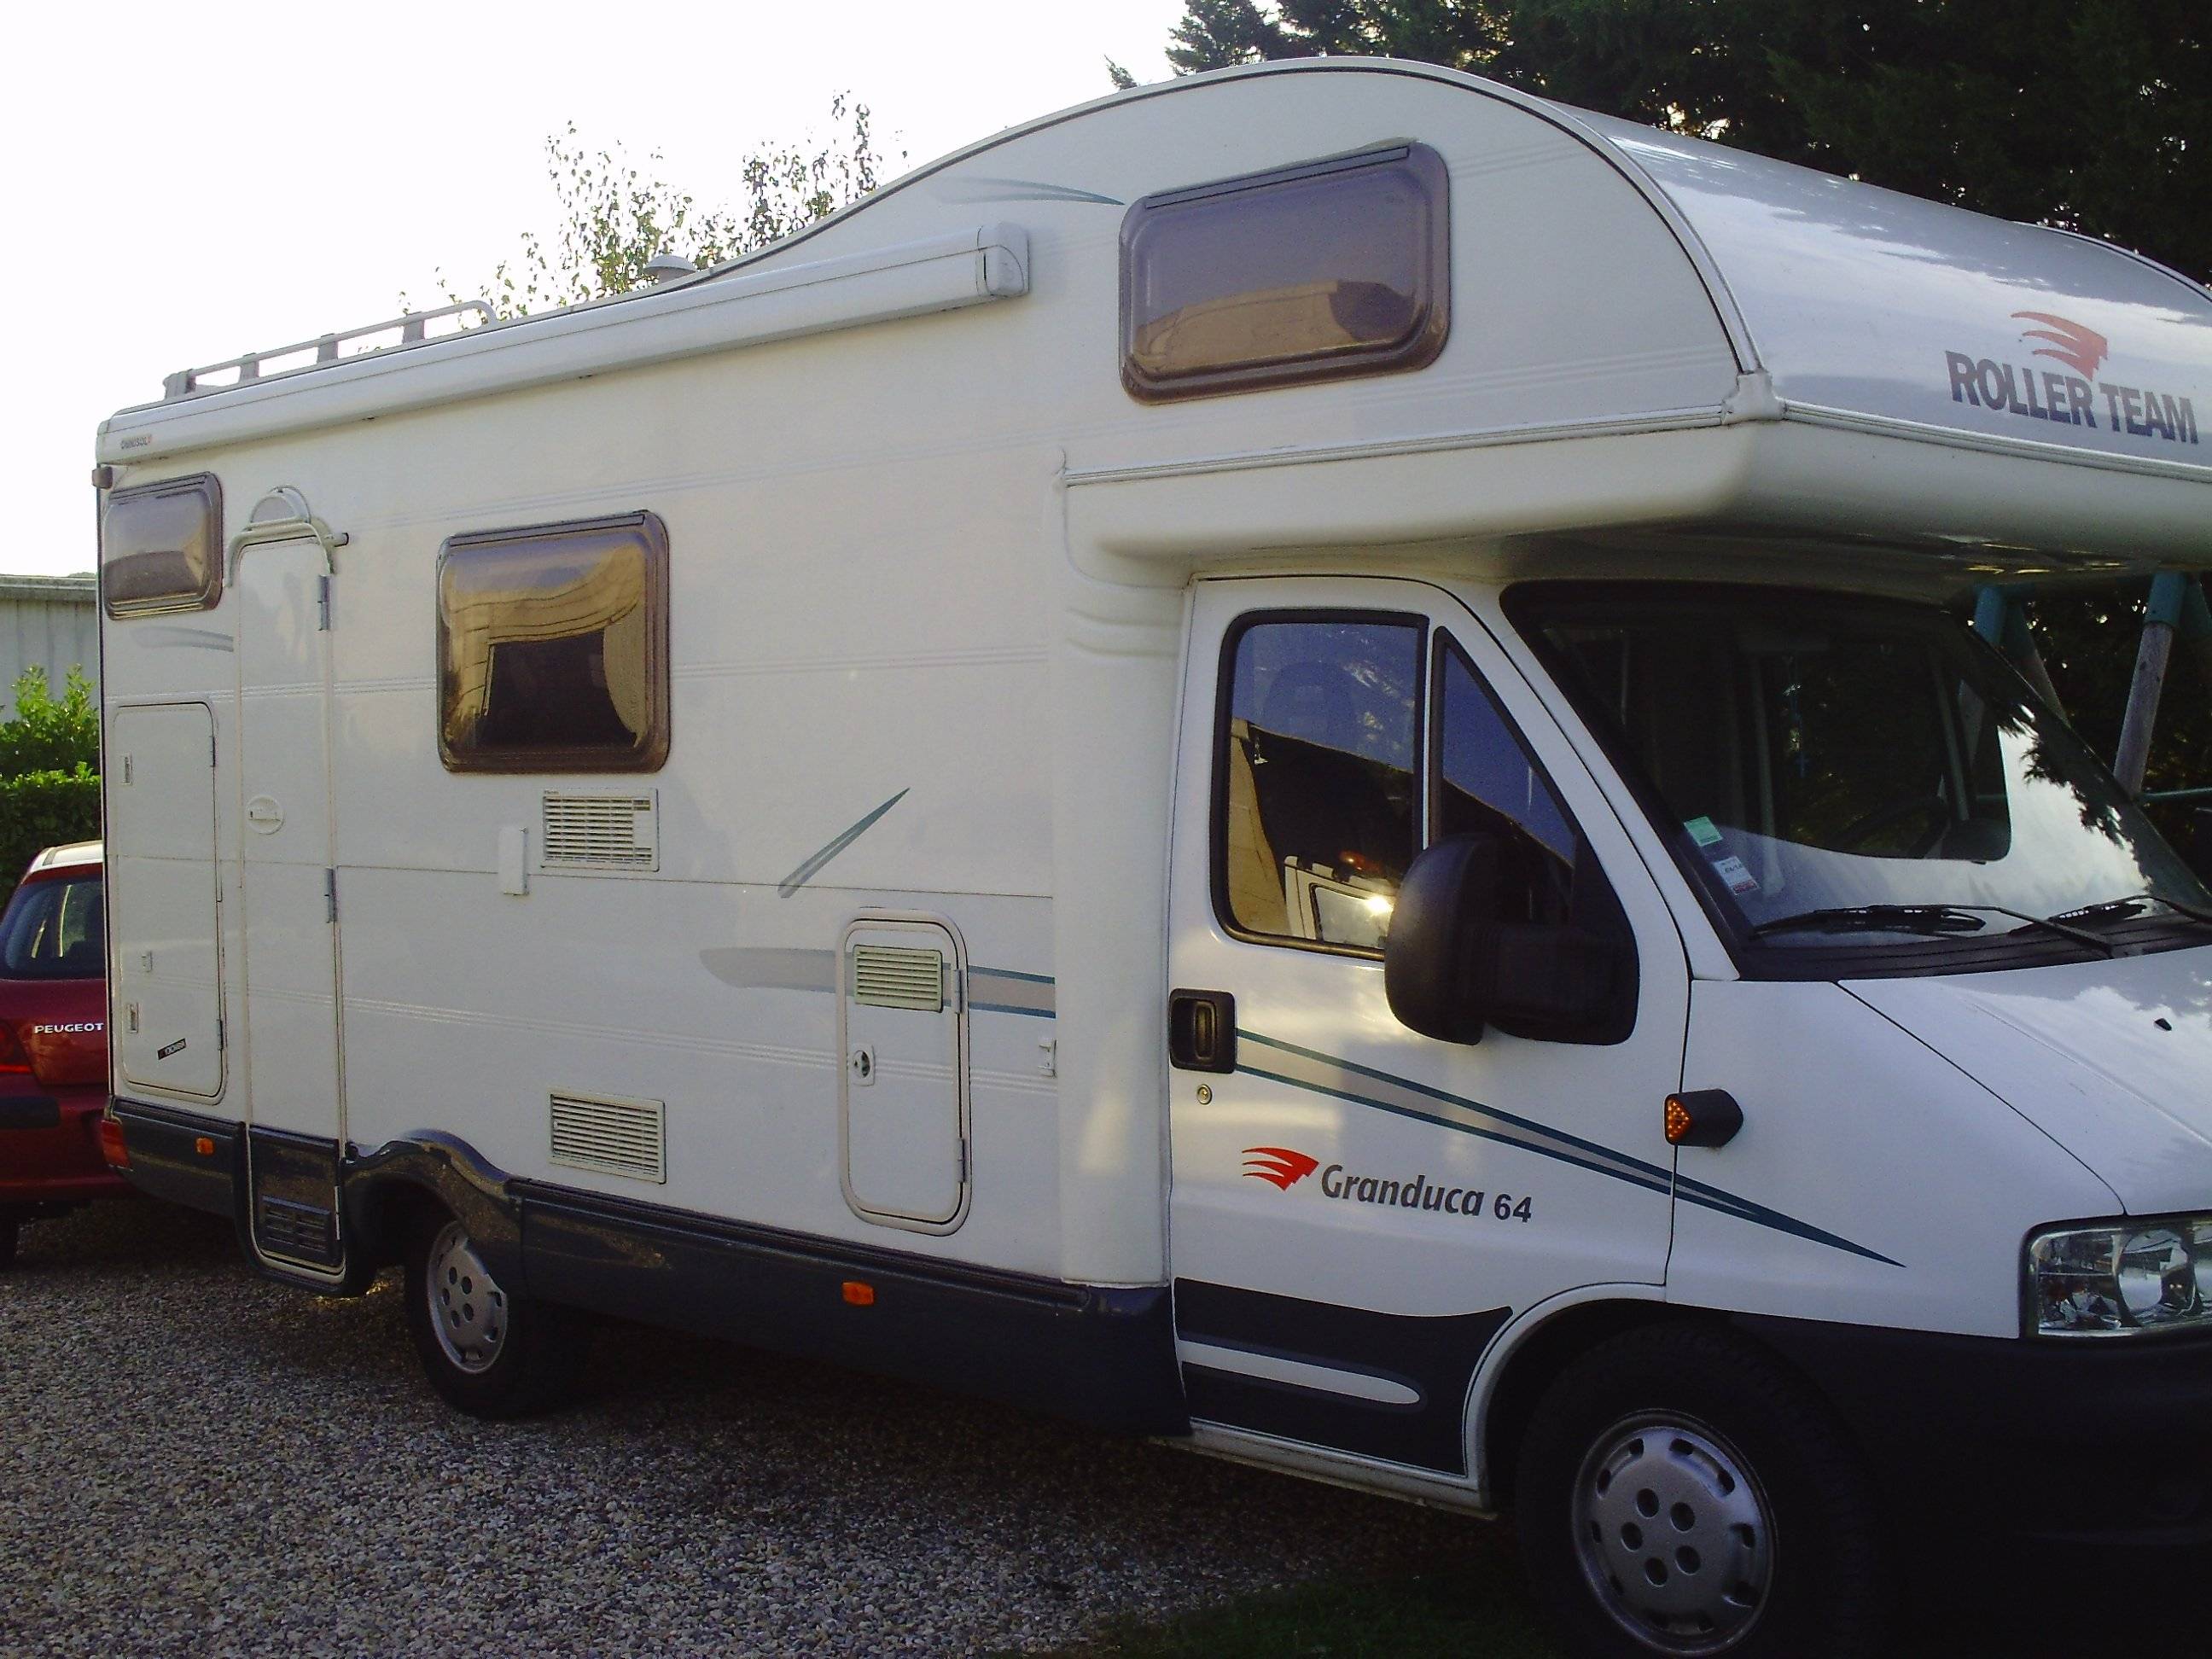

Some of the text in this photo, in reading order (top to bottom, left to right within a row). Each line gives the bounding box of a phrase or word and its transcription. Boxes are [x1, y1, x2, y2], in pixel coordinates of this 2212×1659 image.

[1946, 351, 2199, 445] ROLLER TEAM
[34, 1023, 104, 1034] PEUGEOT
[1321, 1164, 1533, 1224] Granduca 64
